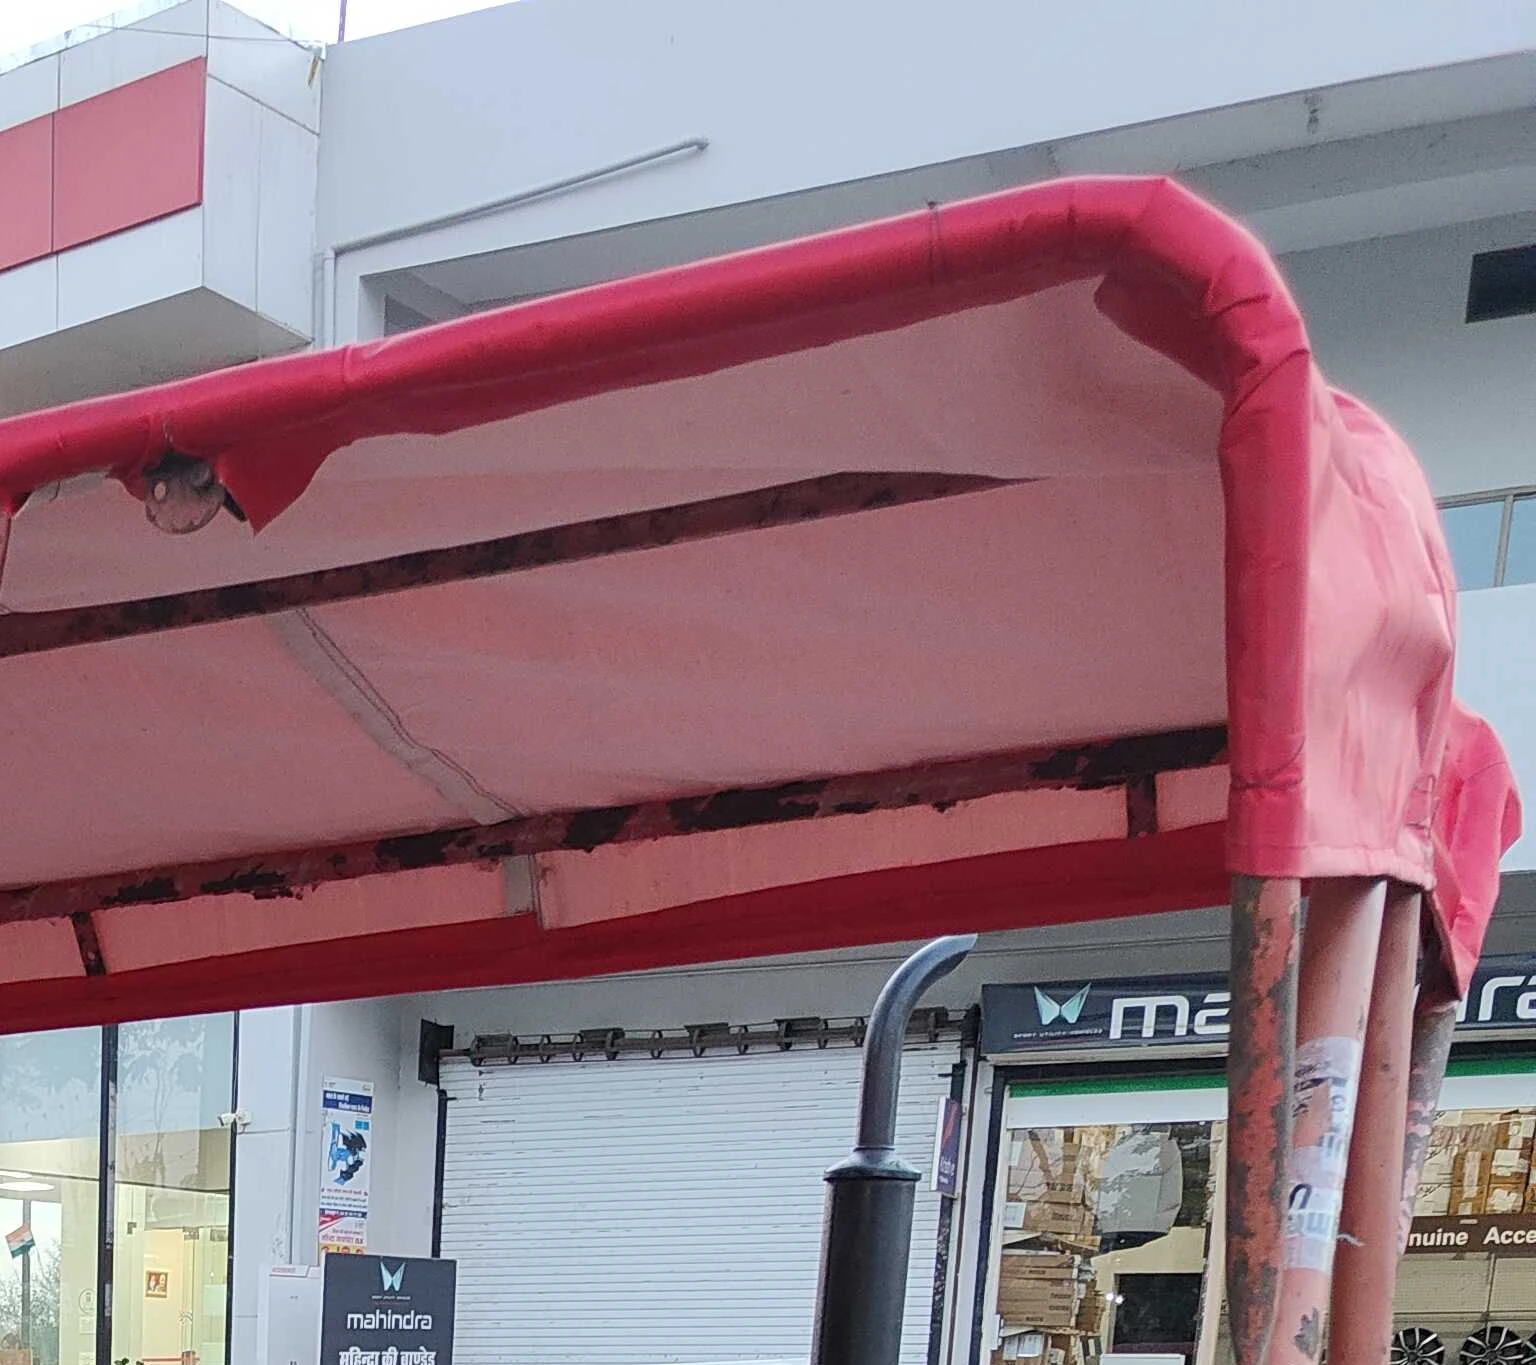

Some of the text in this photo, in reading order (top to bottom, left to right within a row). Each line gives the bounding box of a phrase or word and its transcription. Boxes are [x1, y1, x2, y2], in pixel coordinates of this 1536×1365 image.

[1408, 1226, 1536, 1246] nuine Acce
[347, 1309, 432, 1330] mahindra
